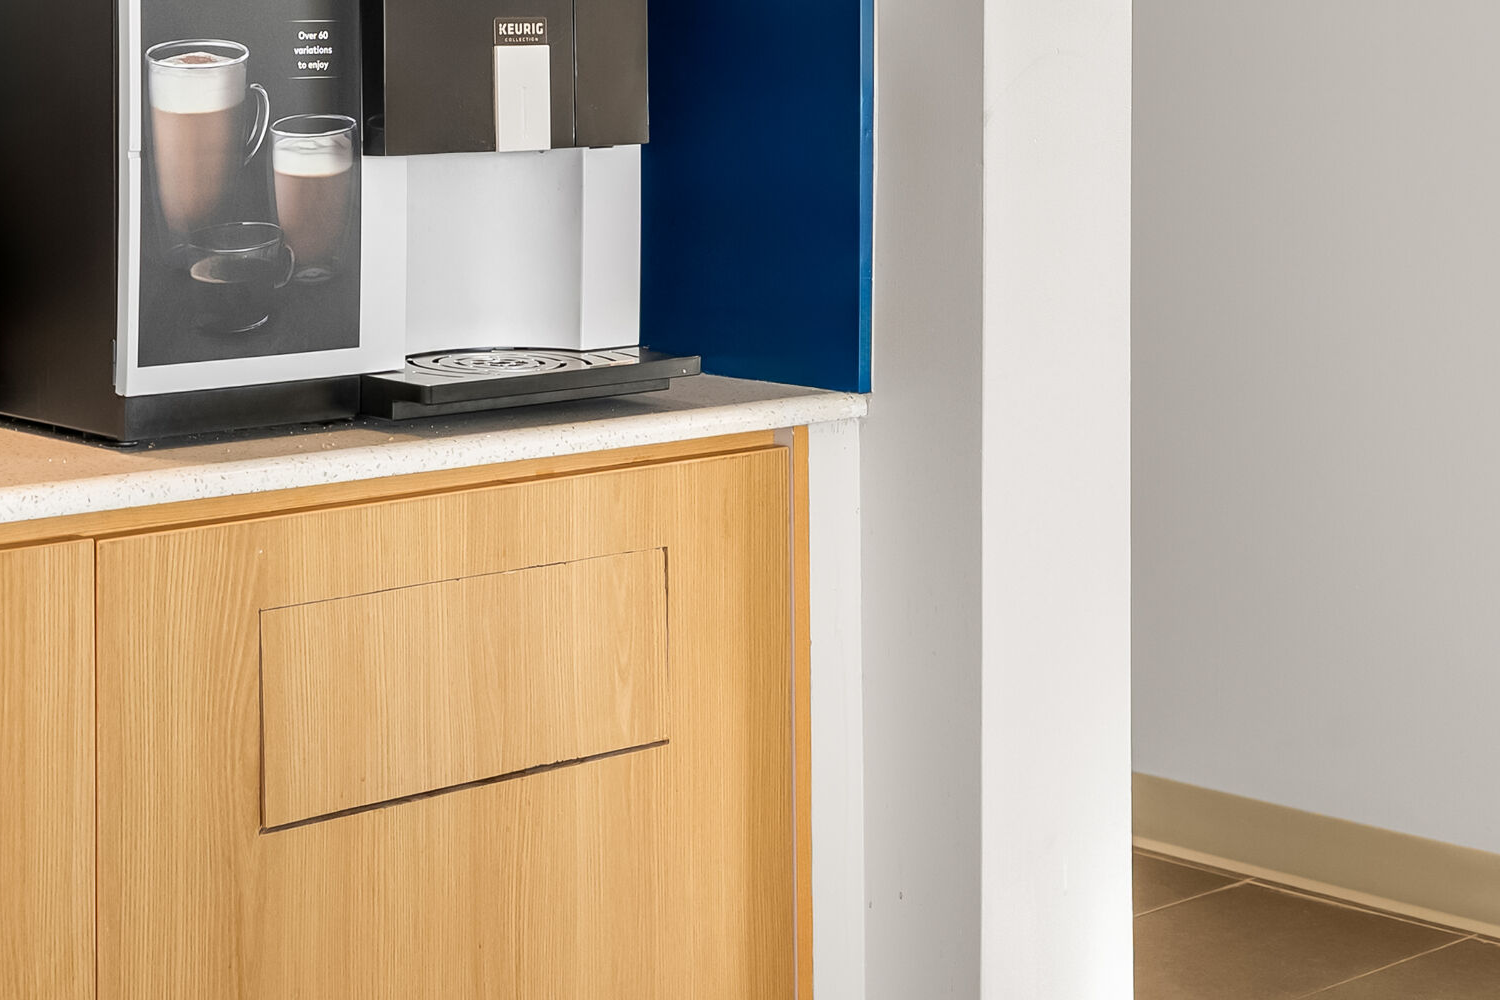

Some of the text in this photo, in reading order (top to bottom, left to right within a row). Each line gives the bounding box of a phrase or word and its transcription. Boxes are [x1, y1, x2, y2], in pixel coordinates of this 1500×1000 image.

[498, 22, 544, 36] KEURIG
[298, 30, 329, 40] Over 60
[293, 45, 333, 55] variations
[297, 60, 330, 71] to enjoy
